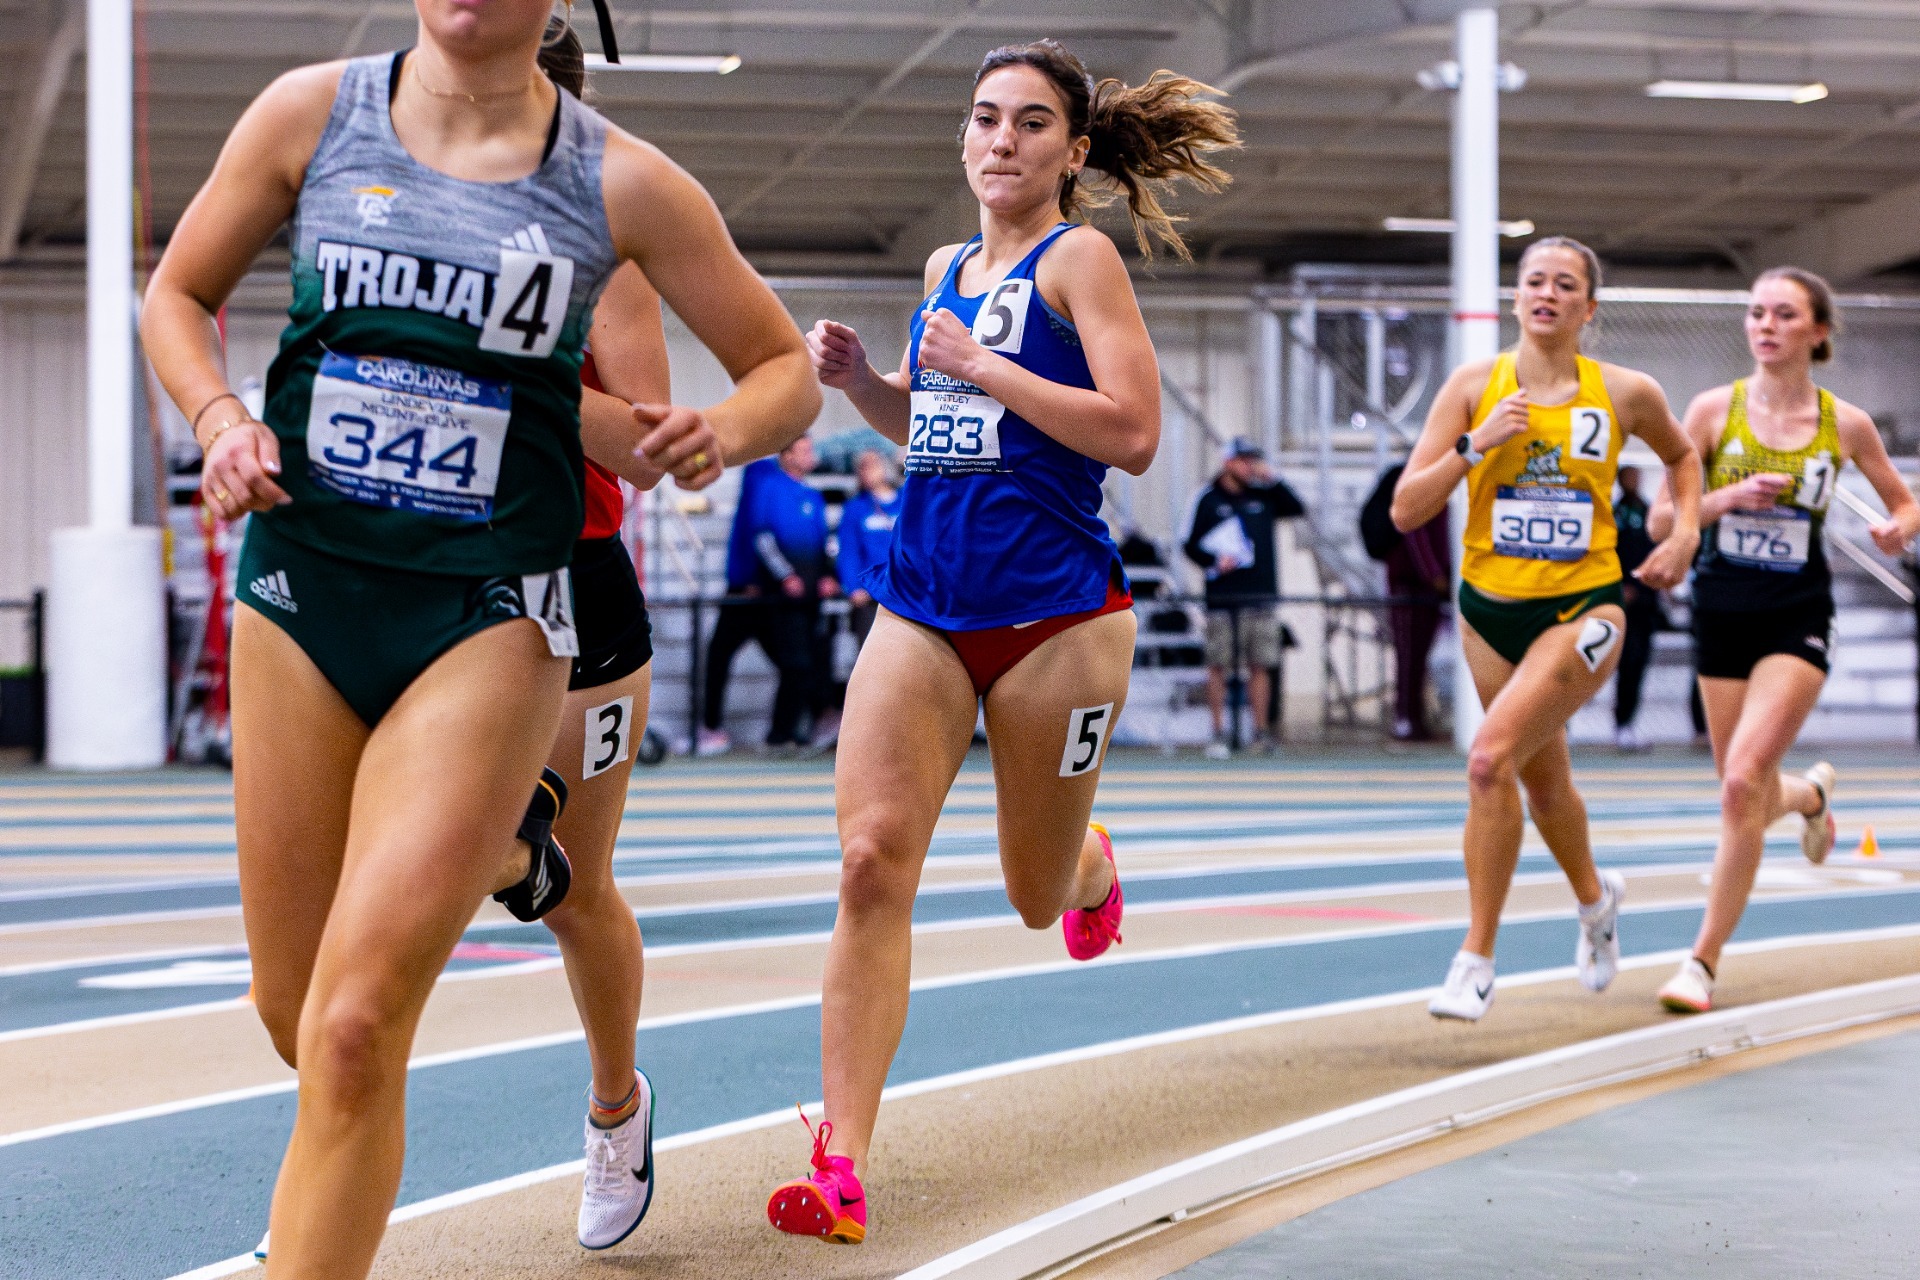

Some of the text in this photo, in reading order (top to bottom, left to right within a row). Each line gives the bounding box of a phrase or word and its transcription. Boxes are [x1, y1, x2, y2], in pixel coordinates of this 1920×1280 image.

[317, 241, 499, 328] TROJA
[501, 263, 554, 350] 4
[980, 284, 1020, 347] 5
[356, 359, 482, 399] CAROLINAS
[933, 393, 972, 405] WHITLEY
[939, 403, 960, 413] KING
[323, 413, 478, 489] 344
[910, 413, 985, 455] 283
[1579, 411, 1601, 457] 2
[1816, 466, 1828, 505] 1
[1500, 515, 1582, 546] 309
[1734, 526, 1793, 557] 176
[249, 580, 299, 614] adidas
[1583, 619, 1612, 663] 2
[593, 703, 623, 771] 3
[1071, 709, 1106, 772] 5
